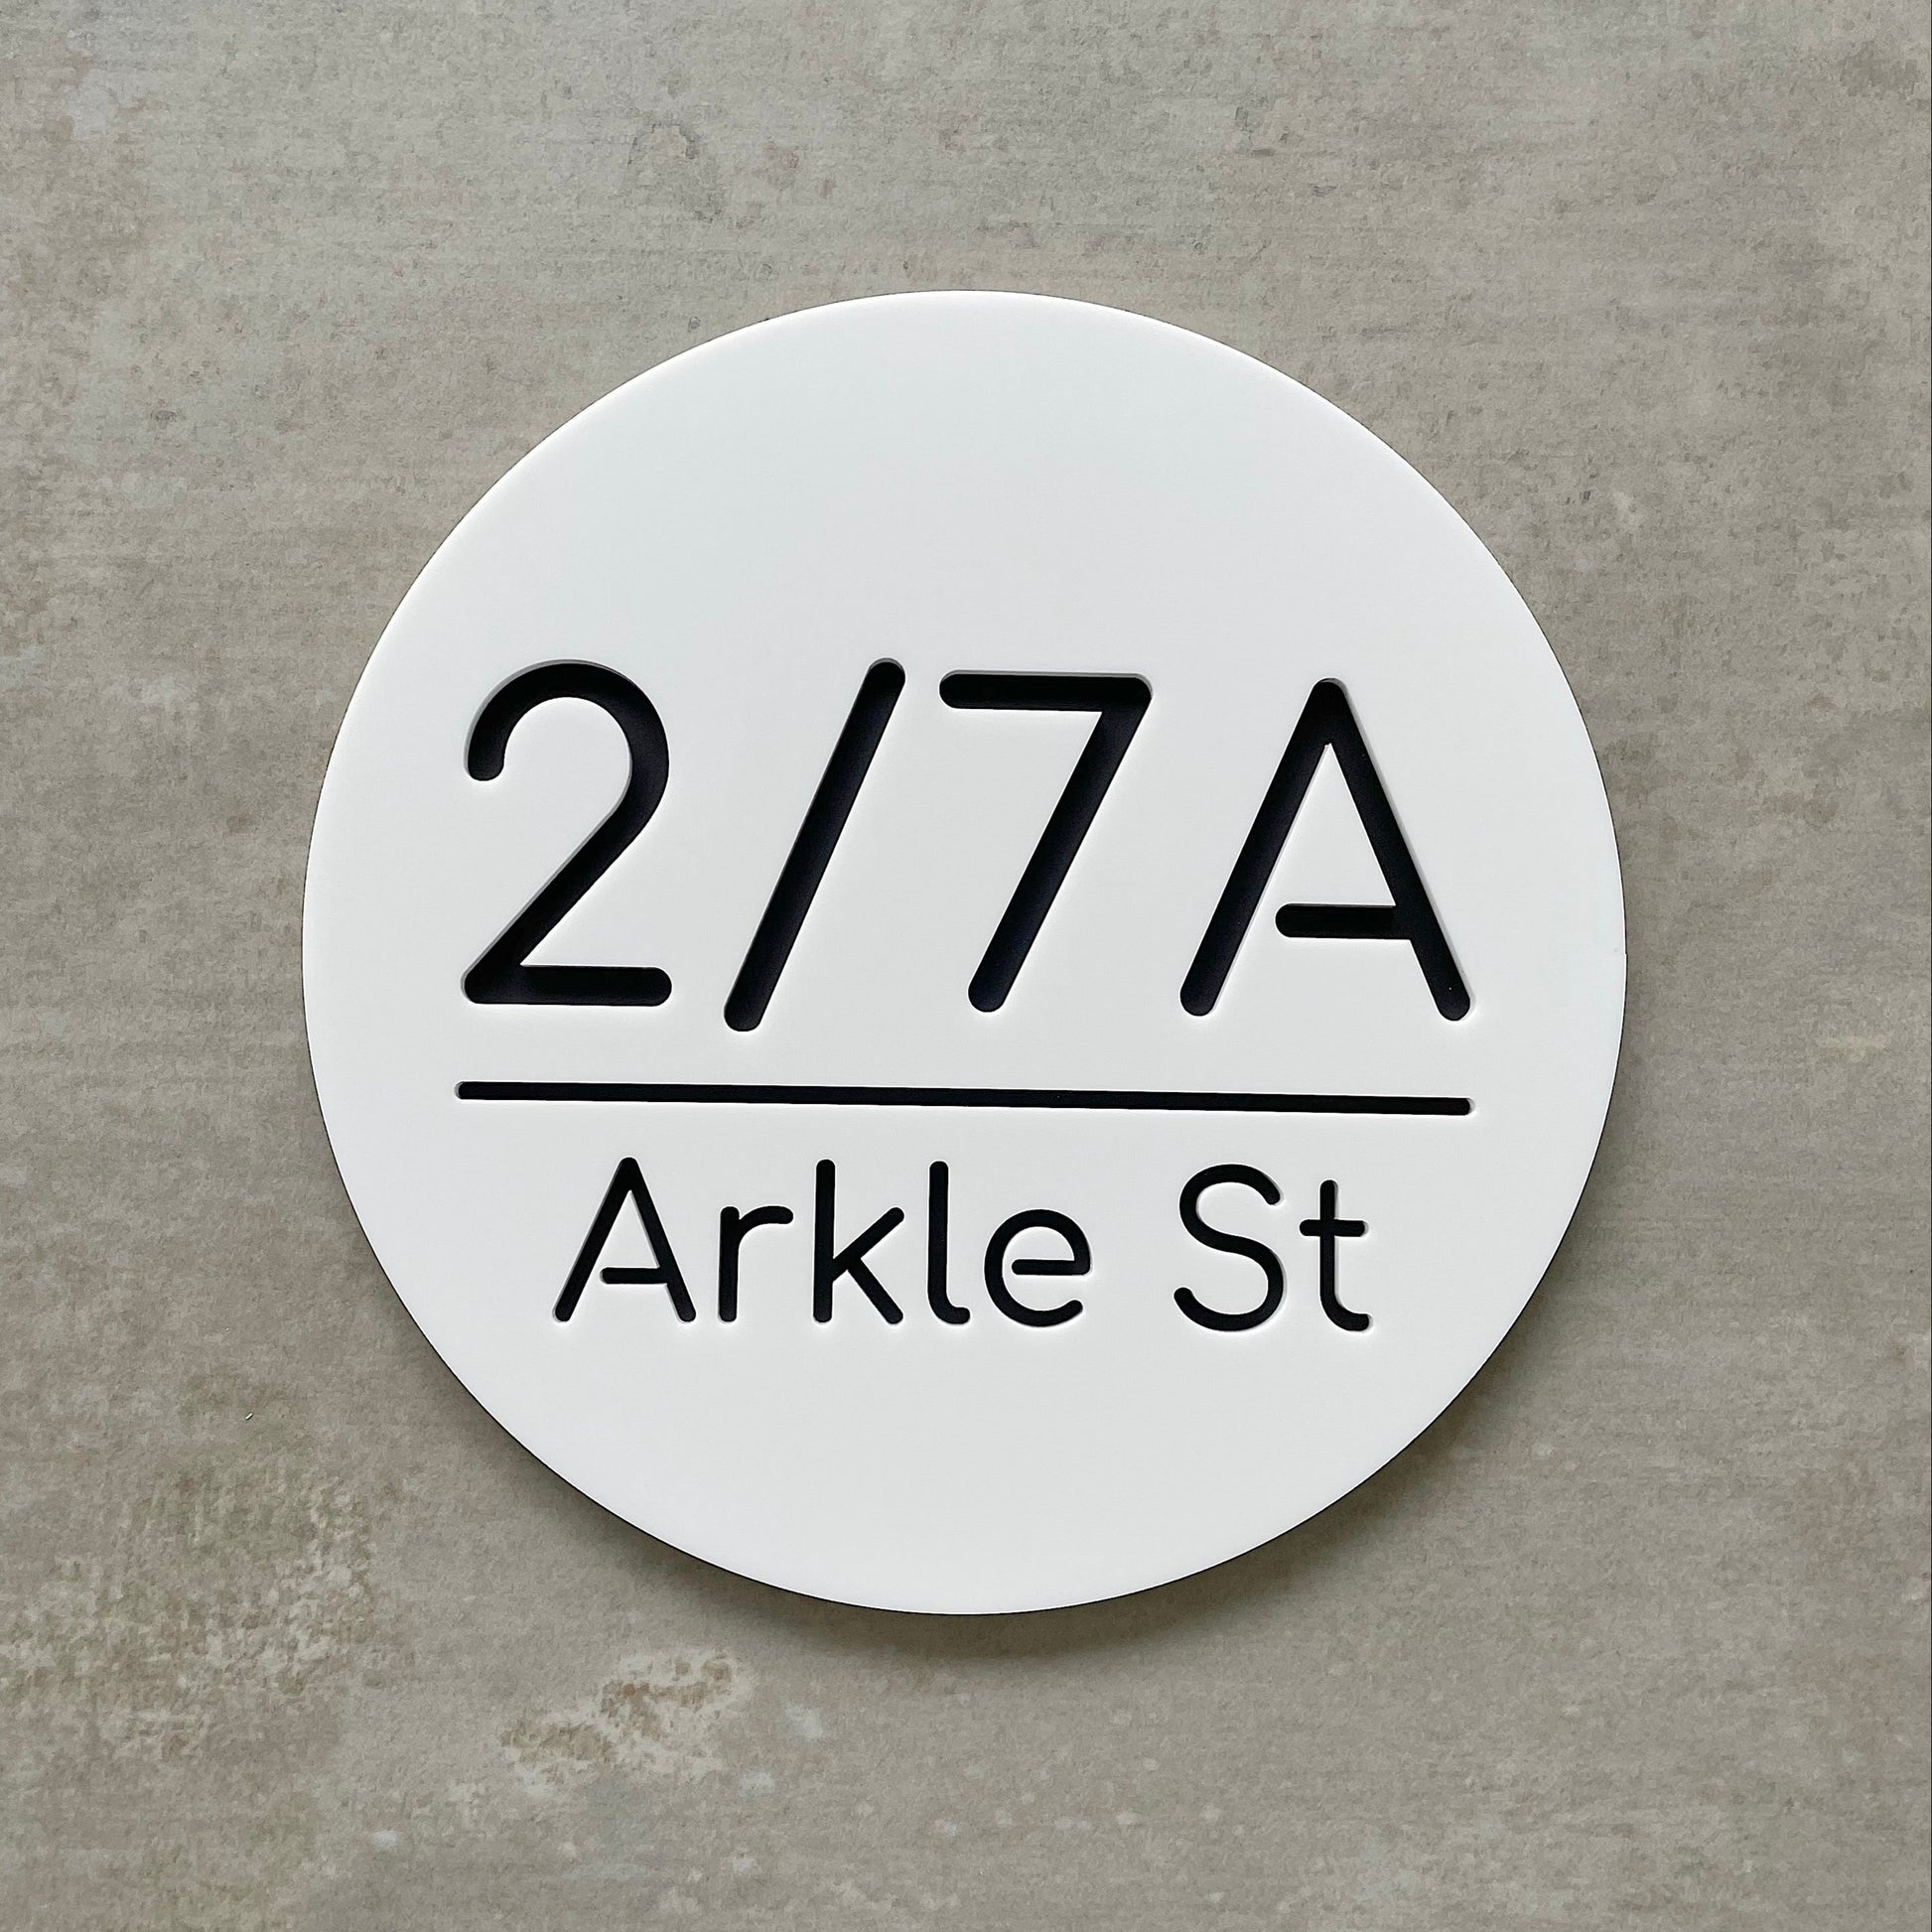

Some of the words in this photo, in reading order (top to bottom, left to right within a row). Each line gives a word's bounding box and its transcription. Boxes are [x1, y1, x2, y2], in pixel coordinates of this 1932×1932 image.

[463, 656, 1472, 1033] 2/7A
[552, 1156, 1093, 1329] Arkle
[1172, 1163, 1373, 1333] St
